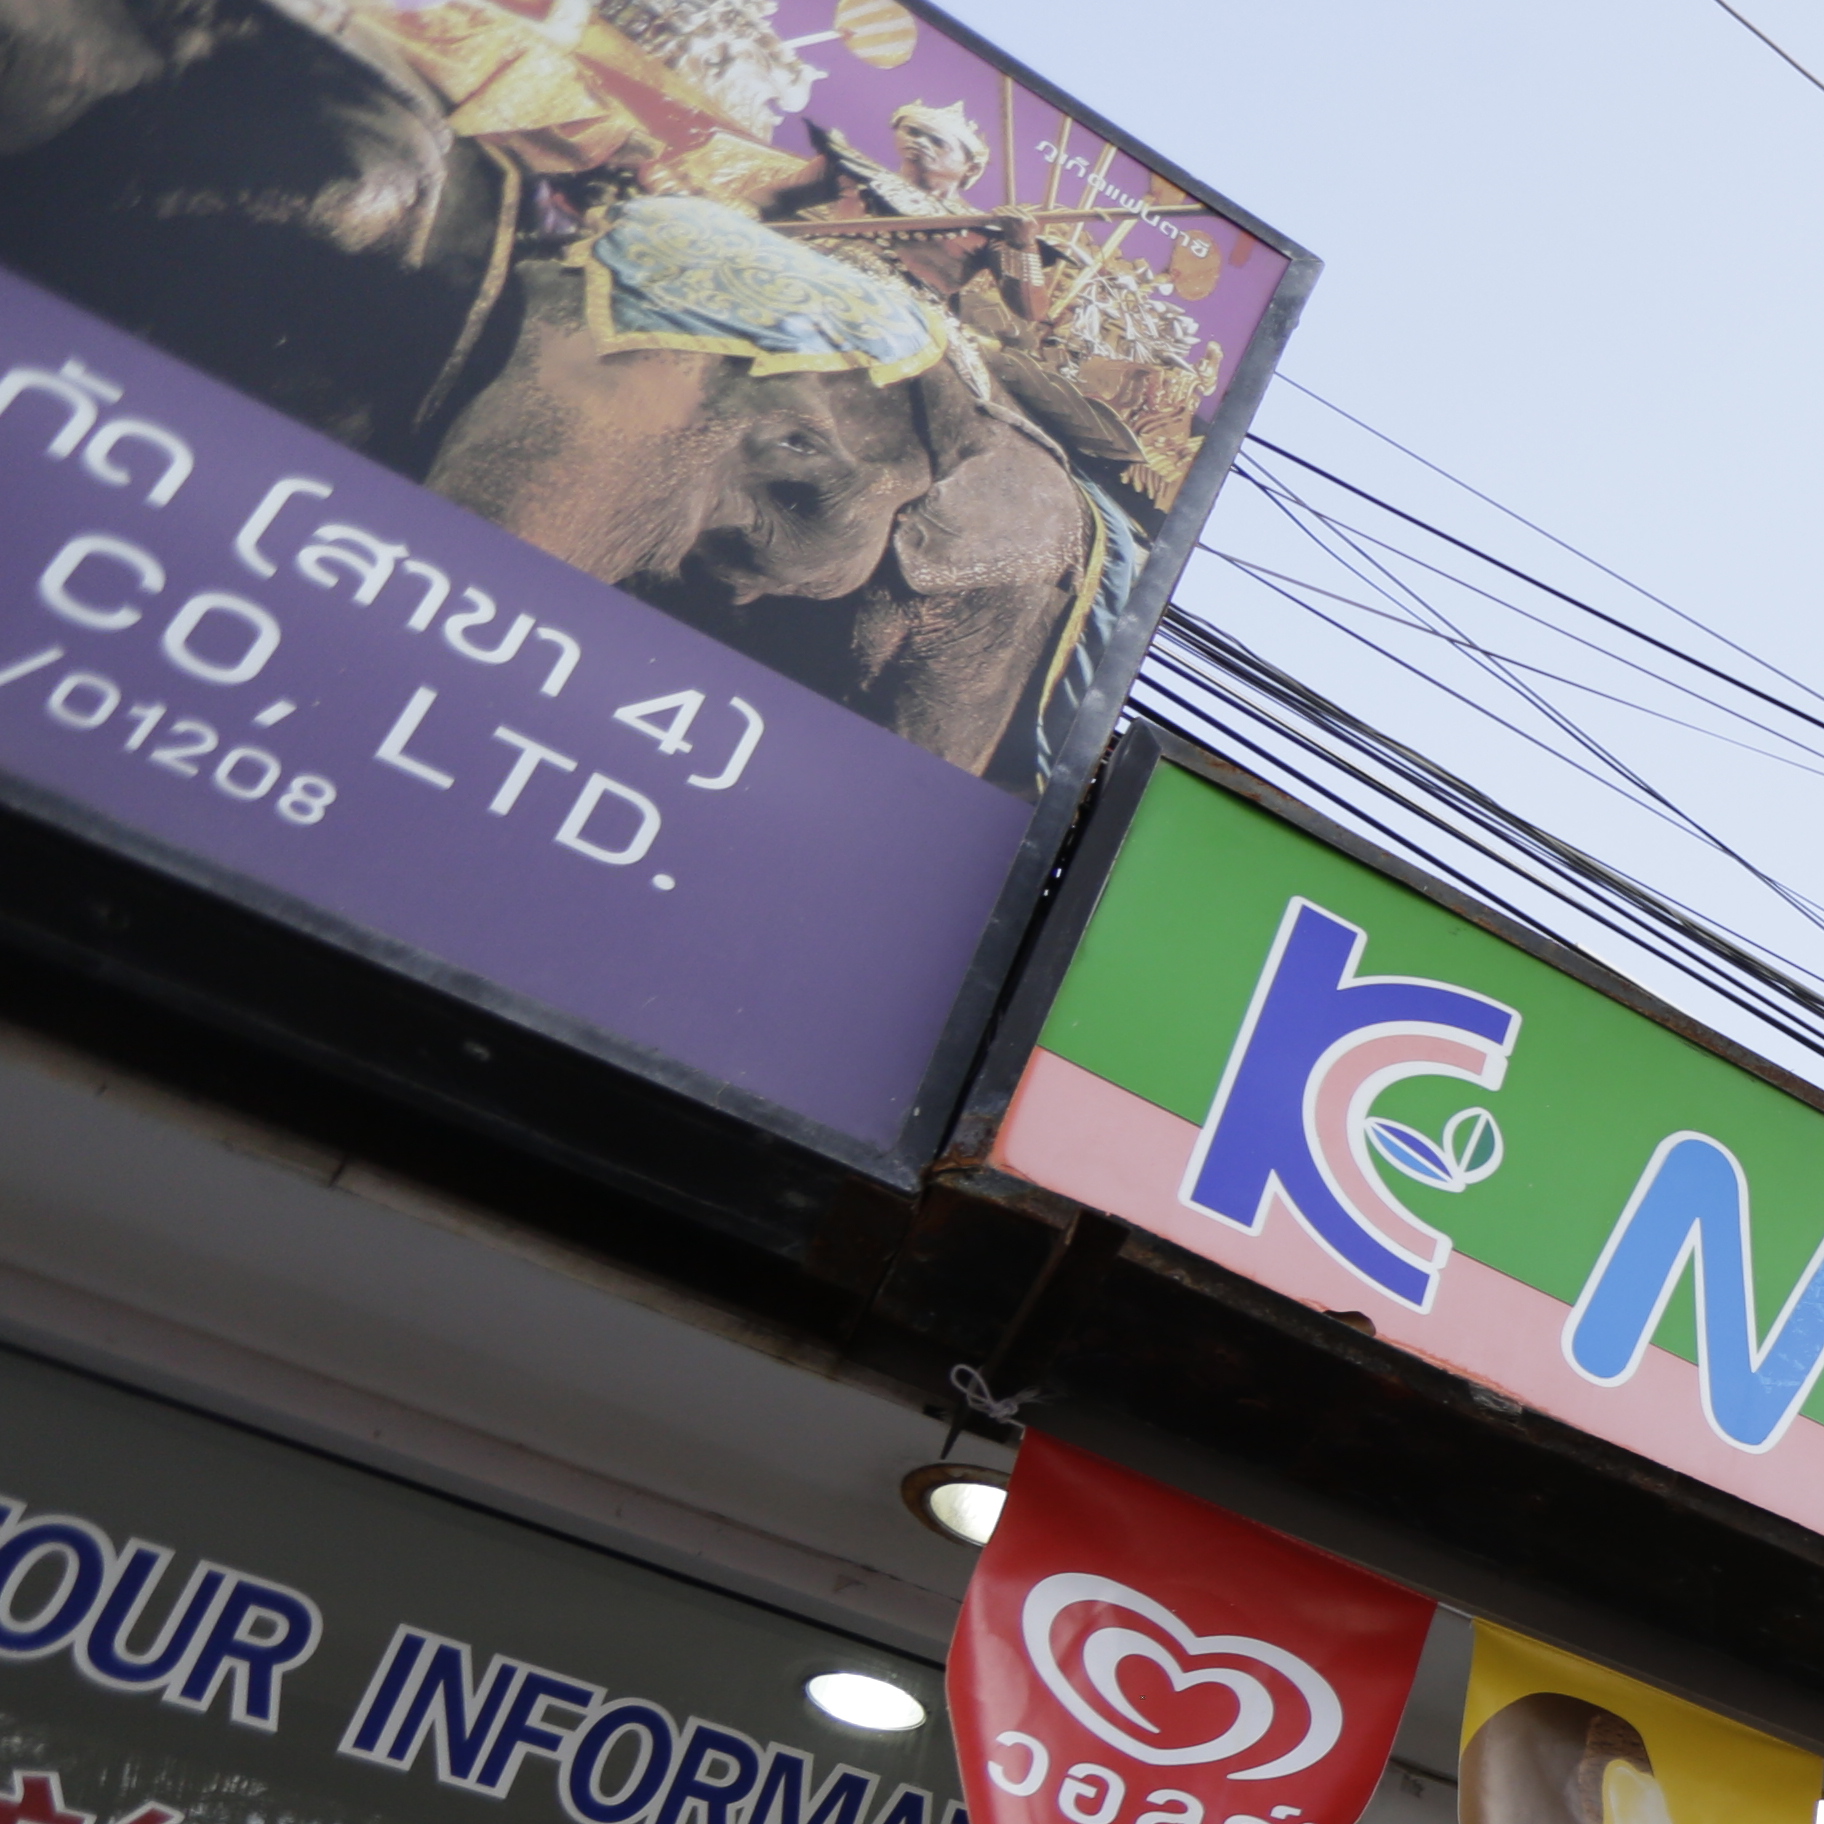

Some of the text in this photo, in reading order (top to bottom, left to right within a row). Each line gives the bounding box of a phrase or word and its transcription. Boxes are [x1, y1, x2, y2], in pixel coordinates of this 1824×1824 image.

[373, 685, 677, 891] LTD.
[612, 688, 765, 791] 4)
[0, 1493, 323, 1735] OUR
